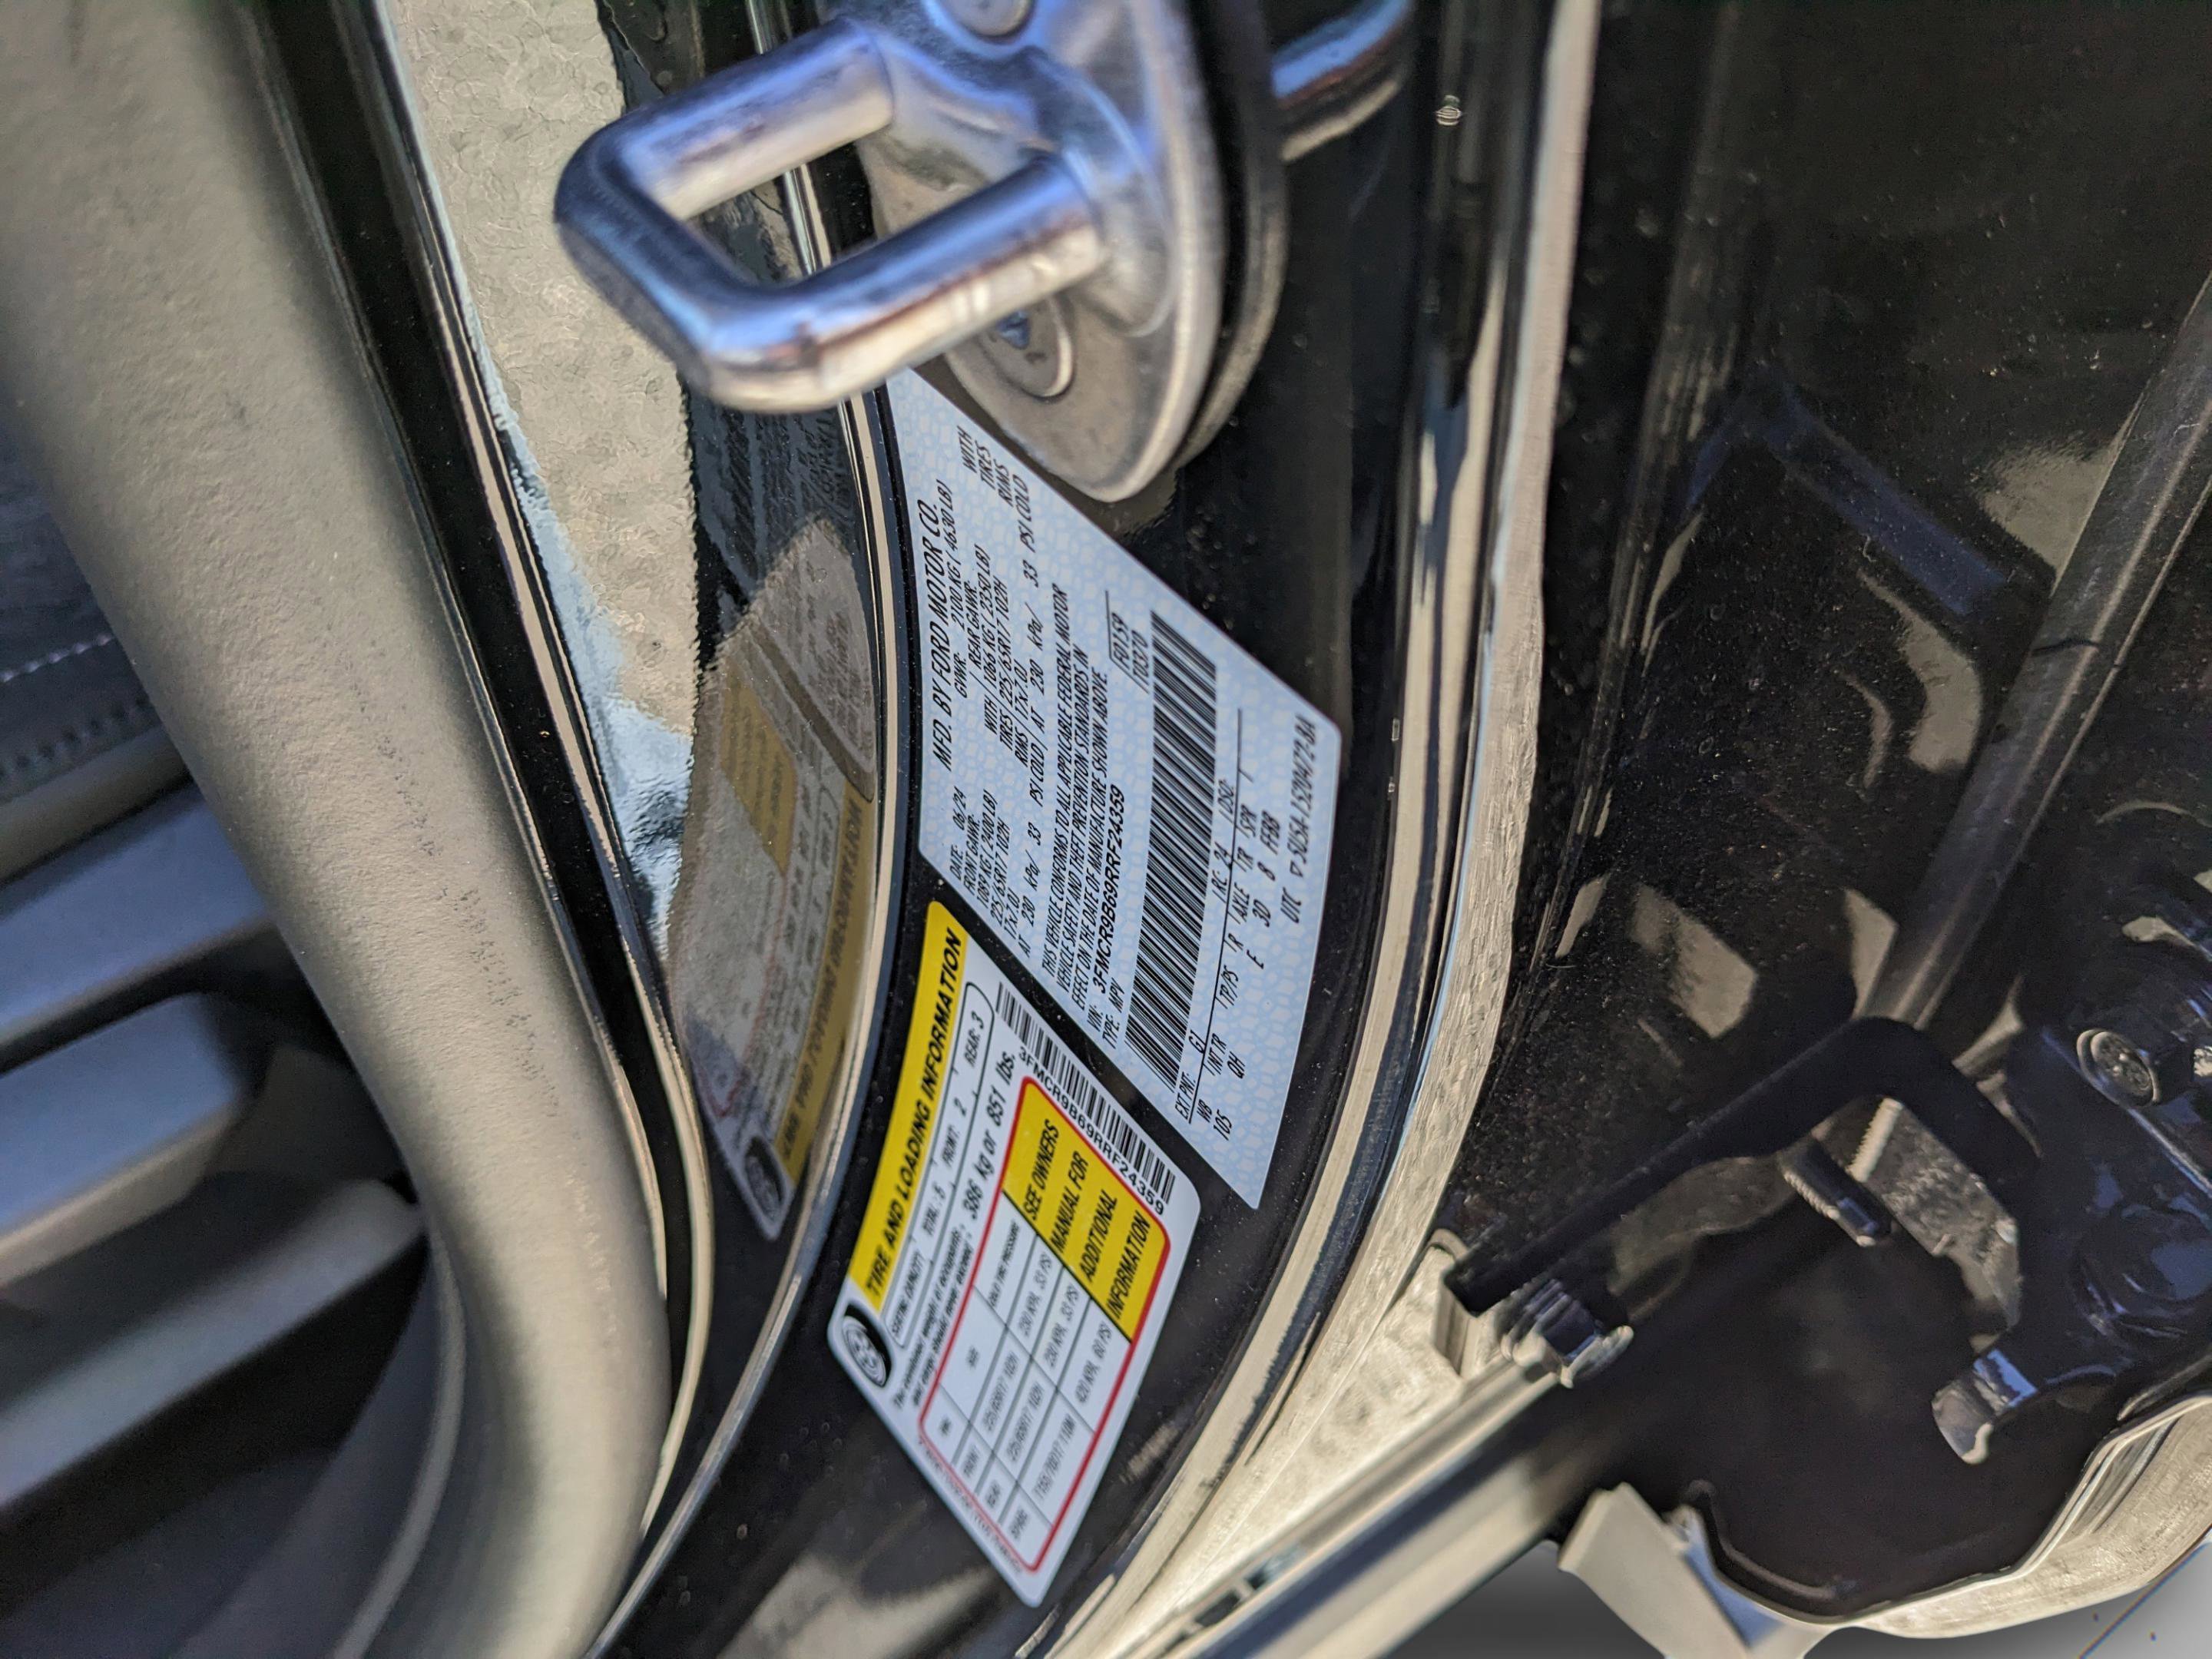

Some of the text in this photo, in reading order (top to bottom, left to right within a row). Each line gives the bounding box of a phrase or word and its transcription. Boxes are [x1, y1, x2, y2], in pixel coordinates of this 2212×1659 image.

[957, 426, 977, 474] WITH
[975, 439, 995, 491] TIRES
[994, 459, 1013, 507] RIMS
[1012, 473, 1031, 522] COLD
[1018, 519, 1035, 553] PSI
[947, 561, 962, 590] KG
[1022, 559, 1038, 588] 33
[949, 585, 965, 631] 2100
[993, 575, 1009, 621] 102H
[917, 499, 952, 772] MFD. BY FORD MOTOR CO.
[964, 579, 982, 670] REAR GAWR:
[982, 624, 995, 652] KG
[953, 651, 967, 699] GVWR:
[982, 648, 997, 690] 1066
[1029, 658, 1045, 695] 230
[984, 694, 998, 736] WITH
[999, 708, 1013, 751] TIRES
[1031, 706, 1045, 734] AT
[1015, 726, 1028, 767] RIMS
[1030, 742, 1044, 783] COLD
[1029, 778, 1043, 807] PSI
[1041, 582, 1072, 978] THIS VEHICLE CONFORMS TO ALL APPLICABLE FEDERAL MOTOR
[1217, 779, 1235, 816] DSO:
[949, 785, 966, 881] DATE: 06/24
[995, 816, 1010, 856] 102H
[1028, 821, 1041, 846] 33
[1056, 644, 1089, 994] VEHICLE SAFETY AND THEFT PREVENTION STANDARDS IN
[1071, 665, 1108, 1011] EFFECT ON THE DATE OF MANUFACTURE SHOWN ABOVE.
[963, 813, 980, 896] FRONT GAWR:
[979, 853, 992, 879] KG
[1212, 841, 1231, 896] RC: 24
[1257, 861, 1276, 882] 8
[977, 873, 990, 909] 1089
[1021, 895, 1035, 927] 230
[1087, 783, 1124, 1033] VIN: 3FMCR9B69RRF24359
[1280, 886, 1302, 925] UTC
[1252, 898, 1271, 928] 3D
[1018, 934, 1031, 958] AT
[1197, 804, 1257, 1124] WB INT TR TP/PS R AXLE TR SPR
[1247, 949, 1264, 969] E
[1102, 977, 1124, 1050] TYPE: MPV
[964, 1010, 985, 1068] REAR: 3
[1179, 1071, 1196, 1101] PNT:
[1227, 1051, 1245, 1080] QH
[866, 1245, 890, 1297] TIRE
[883, 1198, 904, 1250] AND
[896, 1098, 930, 1201] LOADING
[921, 926, 962, 1101] INFORMATION
[953, 1097, 967, 1117] 2
[1175, 1092, 1191, 1123] EXT
[1214, 1108, 1232, 1141] 105
[962, 1049, 1015, 1220] 386 kg or 851 lbs.
[1018, 1045, 1164, 1217] 3FMCR9B69RRF24359
[1023, 1118, 1059, 1221] SEE OWNERS
[1049, 1150, 1088, 1253] MANUAL FOR
[1079, 1187, 1118, 1283] ADDITIONAL
[1106, 1210, 1151, 1320] INFORMATION
